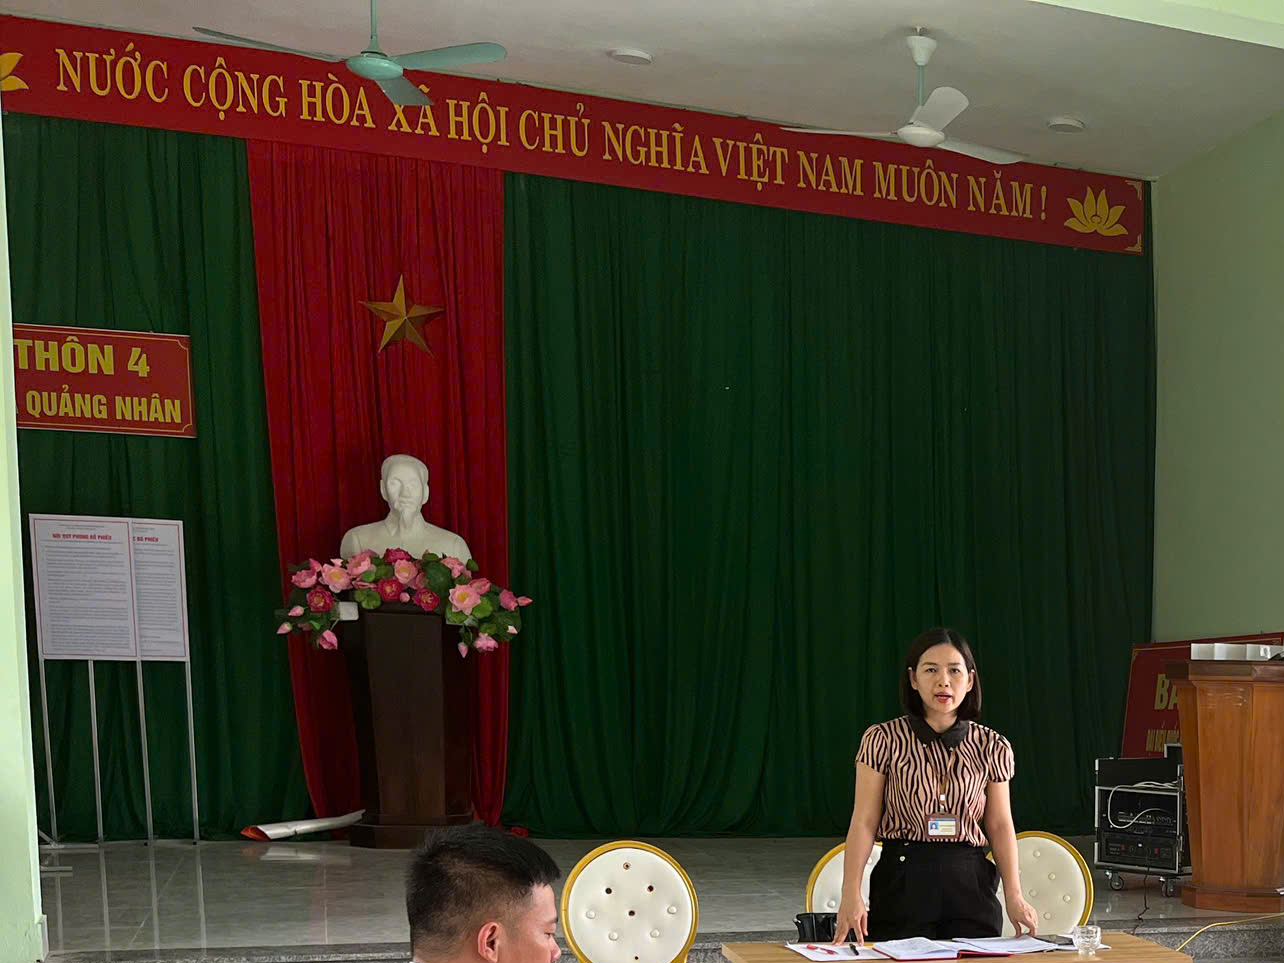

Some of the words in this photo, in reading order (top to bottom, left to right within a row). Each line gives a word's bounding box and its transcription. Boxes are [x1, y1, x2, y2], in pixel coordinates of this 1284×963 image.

[56, 43, 168, 102] NƯỚC
[183, 57, 287, 120] CỘNG
[300, 73, 376, 128] HÒA
[388, 84, 439, 137] XÃ
[446, 92, 510, 154] HỘI
[519, 103, 590, 157] CHỦ
[603, 121, 709, 175] NGHĨA
[713, 133, 788, 192] VIỆT
[798, 150, 865, 196] NAM
[873, 159, 957, 209] MUÔN
[14, 336, 114, 375] THÔN
[128, 347, 150, 377] 4
[26, 385, 107, 419] QUẢNG
[116, 393, 182, 423] NHÂN
